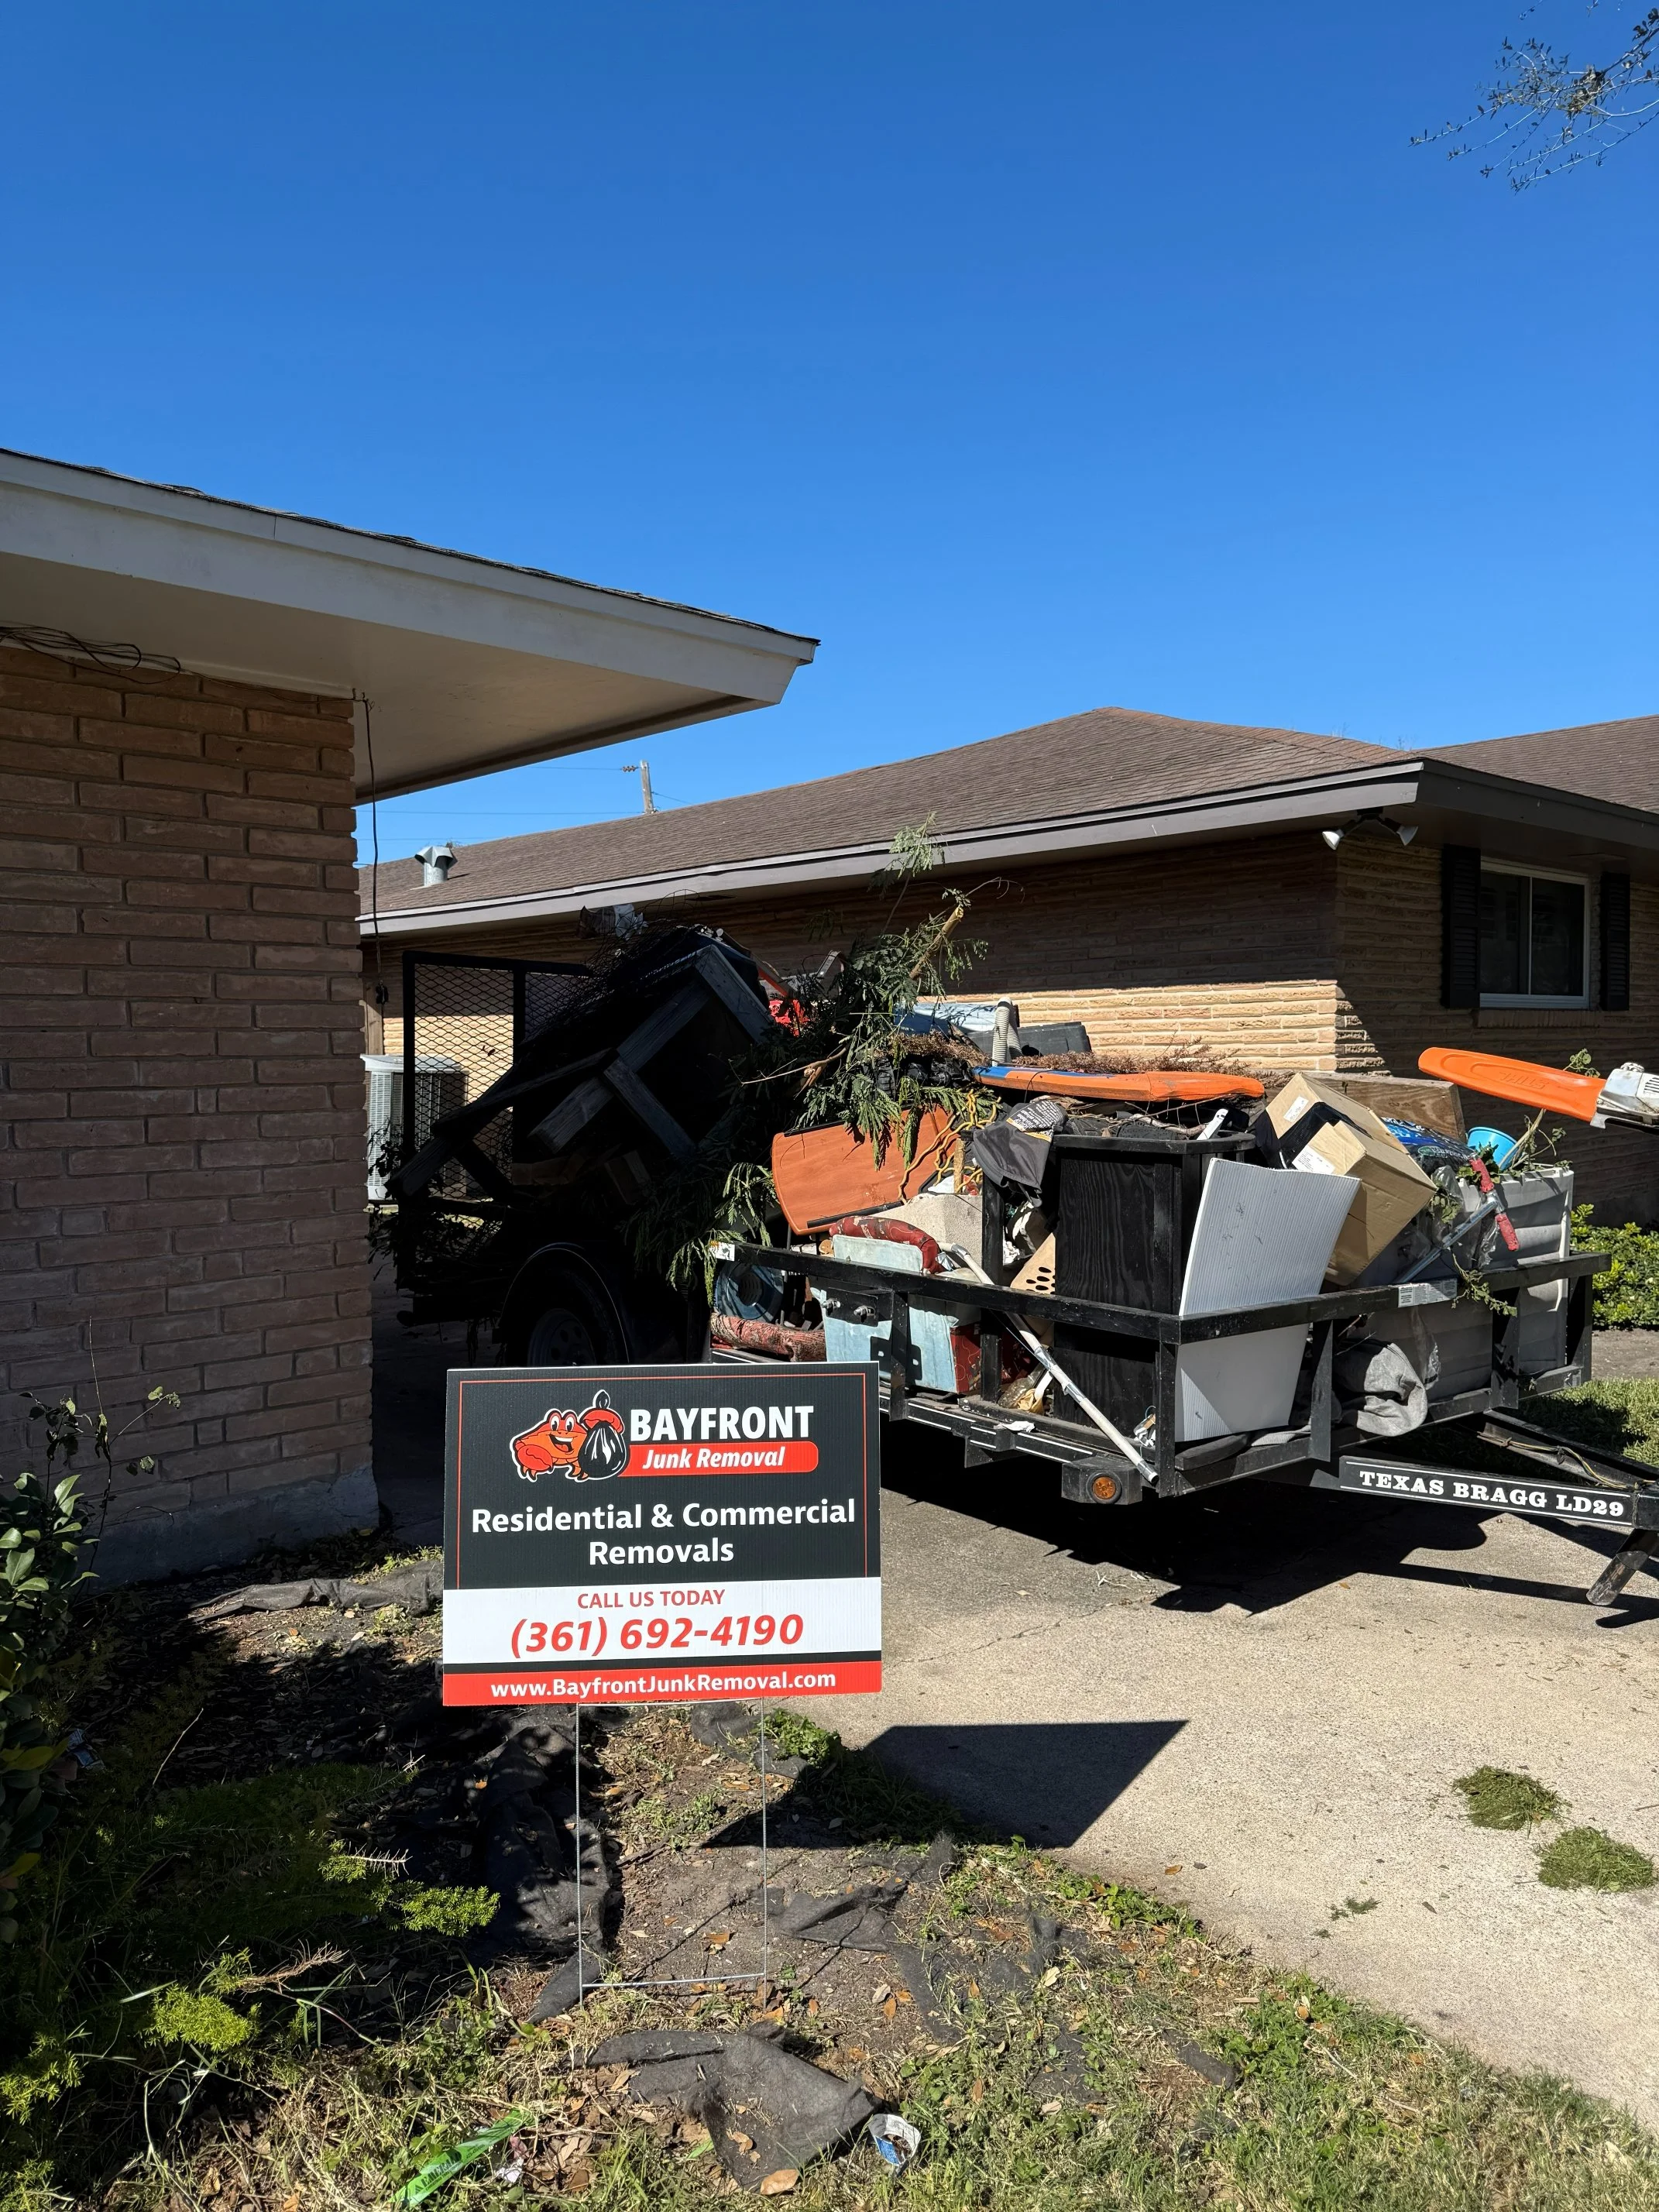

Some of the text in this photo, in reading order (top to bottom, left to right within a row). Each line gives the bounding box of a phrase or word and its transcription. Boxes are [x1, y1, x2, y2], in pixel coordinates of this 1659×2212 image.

[1499, 1072, 1549, 1090] STIHL
[630, 1405, 814, 1441] BAYFRONT
[643, 1446, 786, 1469] Junk Removal
[1359, 1471, 1624, 1517] TEXAS BRAGG LD29
[473, 1499, 855, 1533] Residential & Commercial
[589, 1537, 734, 1565] Removals
[578, 1589, 726, 1609] CALL US TODAY
[511, 1613, 804, 1658] (361) 692-4190
[491, 1671, 836, 1698] www.BayfrontJunkRemoval.com
